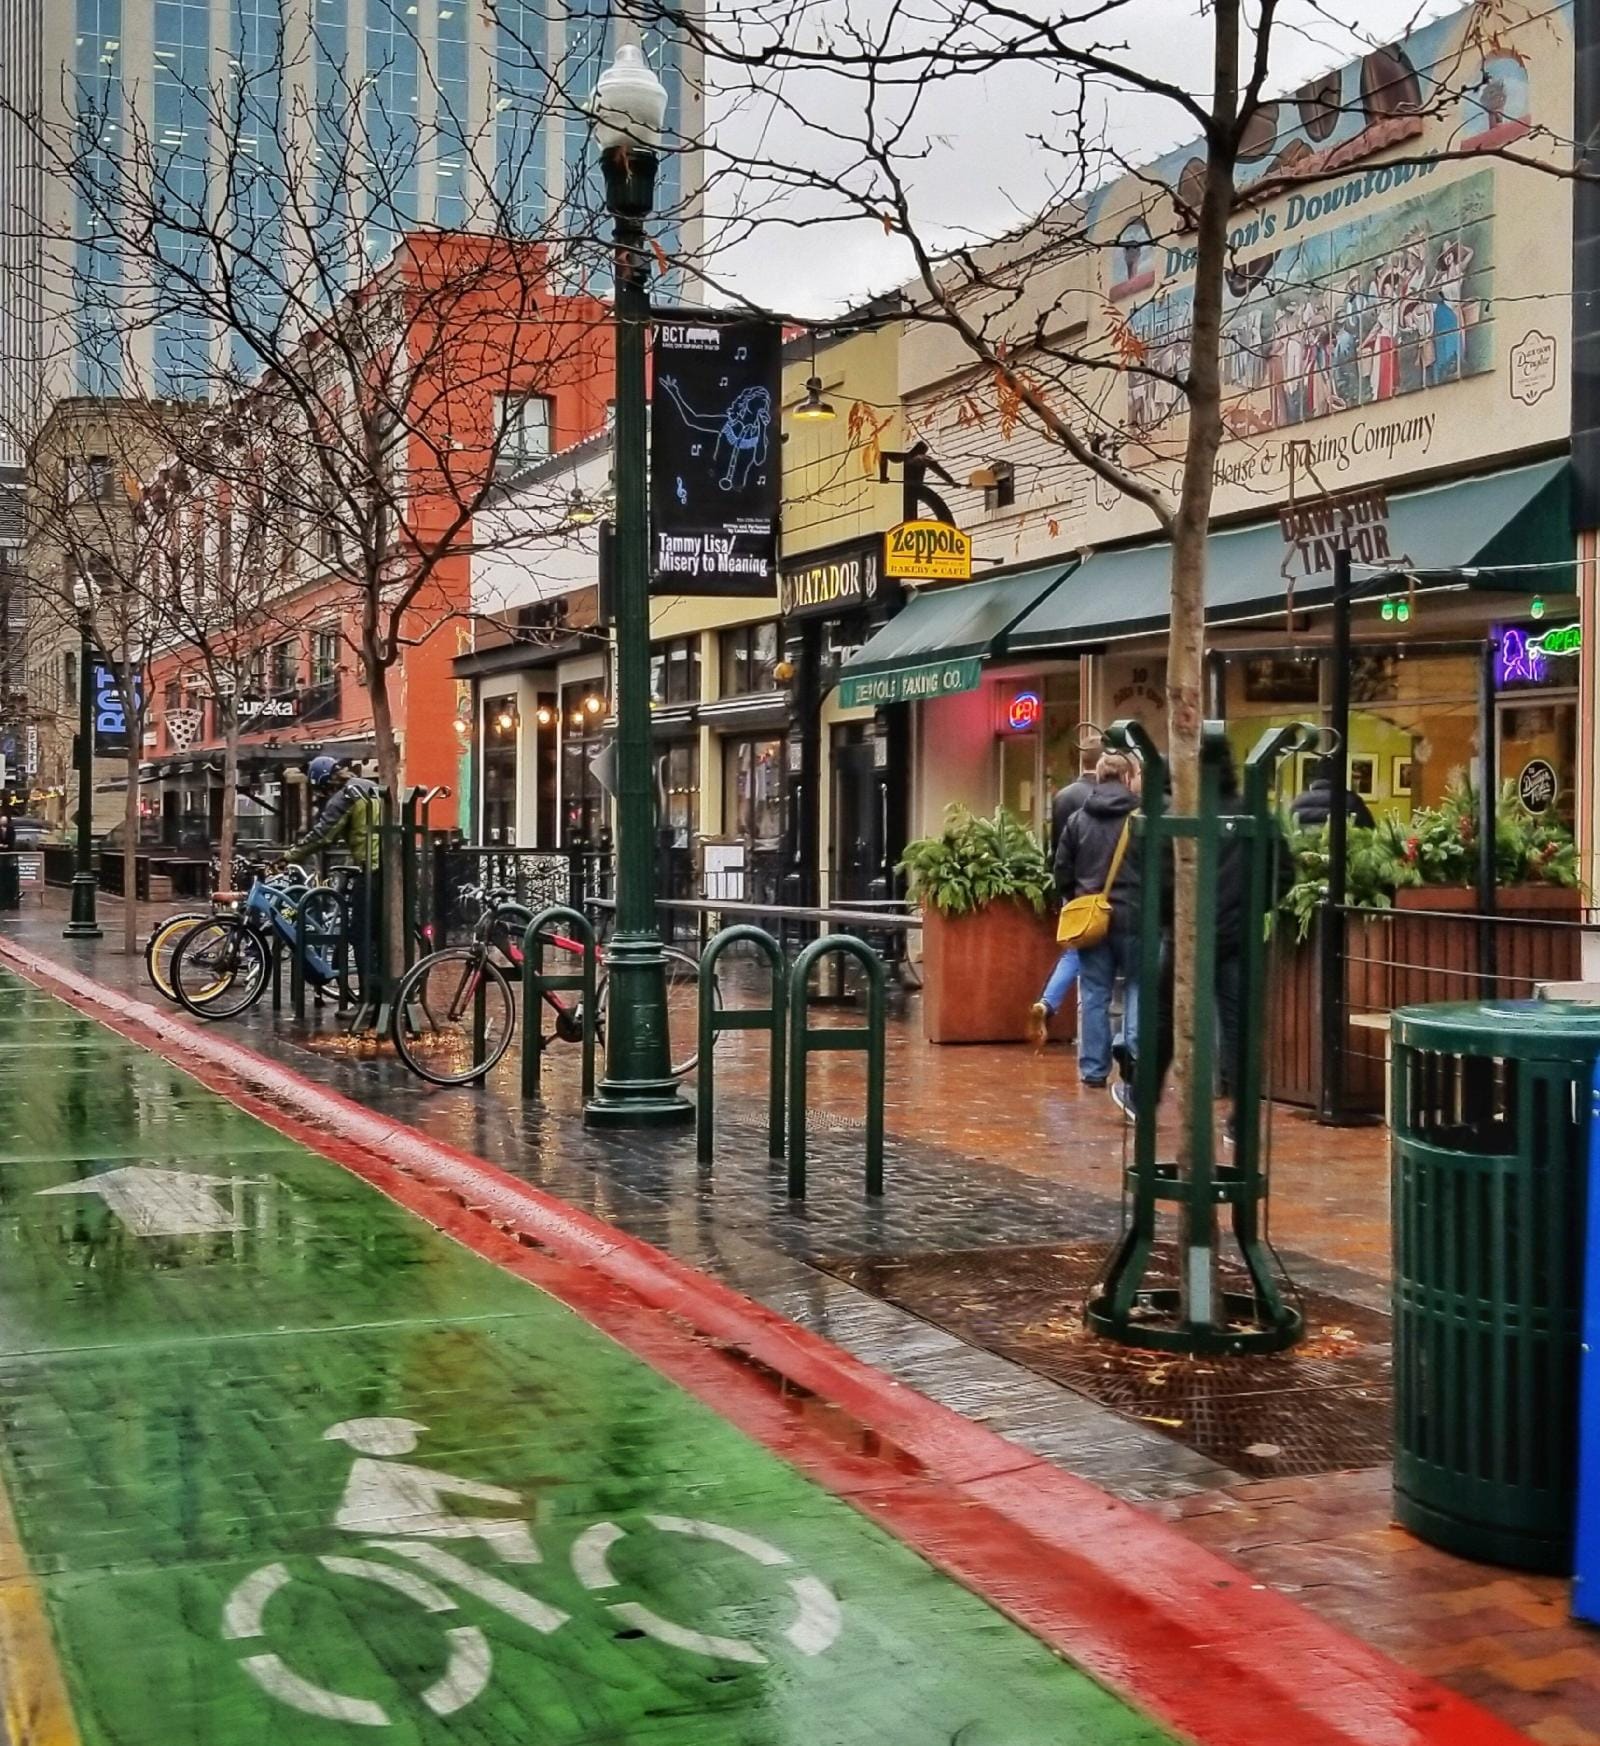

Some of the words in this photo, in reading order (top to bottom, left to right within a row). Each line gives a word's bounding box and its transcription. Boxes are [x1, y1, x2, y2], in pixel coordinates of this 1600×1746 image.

[1165, 208, 1277, 279] Daon's
[1284, 149, 1440, 231] Downtown
[662, 325, 685, 343] BCT
[1280, 435, 1350, 471] Roasting
[1351, 413, 1436, 460] Company
[659, 532, 700, 557] Tammy
[704, 534, 736, 555] Lisa/
[892, 528, 965, 564] Zeppole
[660, 551, 699, 576] Misery
[702, 554, 715, 572] to
[718, 553, 768, 577] Meaning
[891, 565, 929, 575] BAKERY
[1545, 629, 1581, 651] OPEN
[943, 670, 962, 689] CO.
